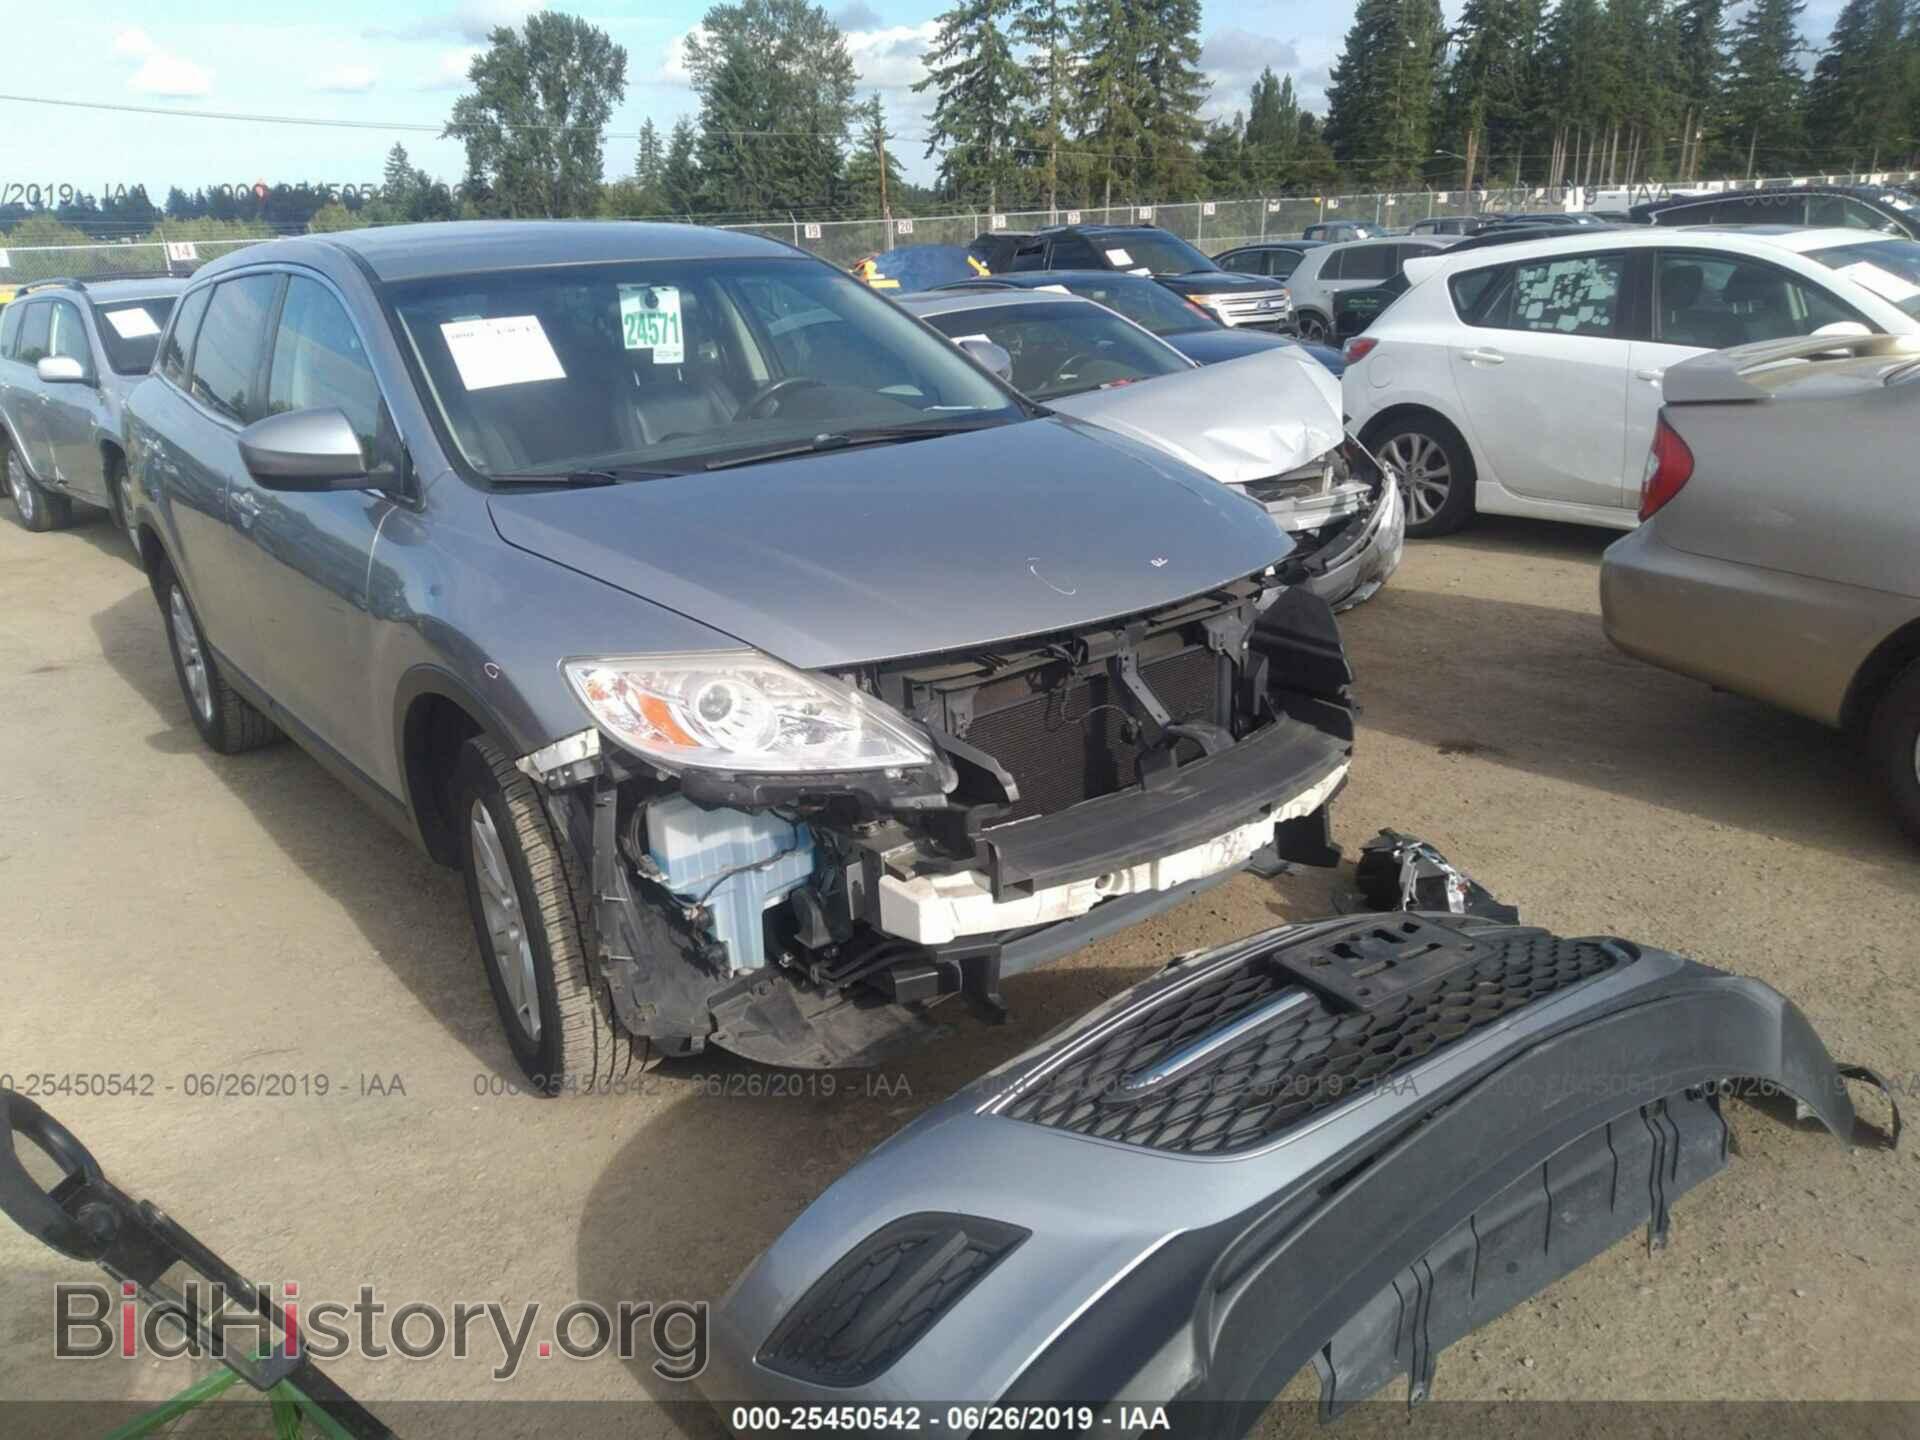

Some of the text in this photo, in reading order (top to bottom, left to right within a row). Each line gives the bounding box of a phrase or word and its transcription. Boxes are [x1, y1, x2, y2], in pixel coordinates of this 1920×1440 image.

[899, 222, 912, 233] 20
[174, 243, 192, 258] 14
[623, 311, 680, 346] 24571
